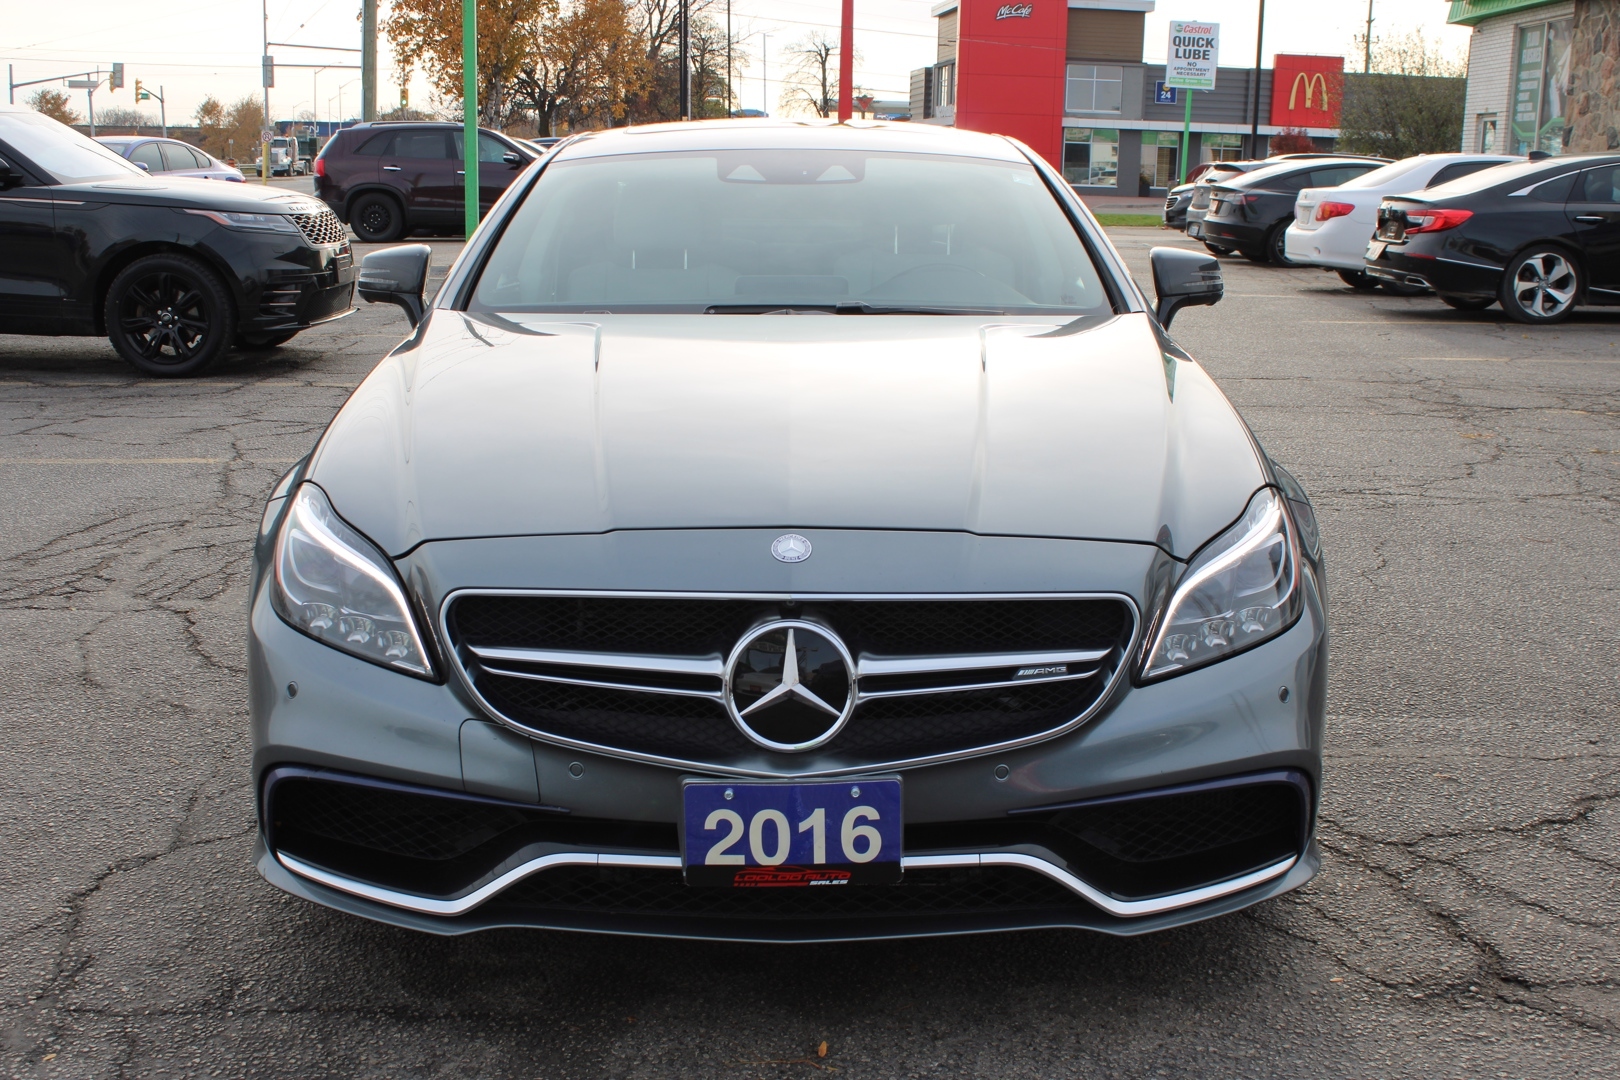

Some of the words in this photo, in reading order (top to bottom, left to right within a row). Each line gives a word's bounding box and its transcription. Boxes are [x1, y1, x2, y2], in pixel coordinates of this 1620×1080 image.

[1183, 25, 1211, 34] Castrol
[1173, 35, 1215, 48] QUICK
[1175, 48, 1211, 60] LUBE
[1161, 91, 1171, 99] 24
[704, 805, 882, 866] 2016
[803, 872, 851, 881] AUTO
[810, 879, 849, 887] SALES
